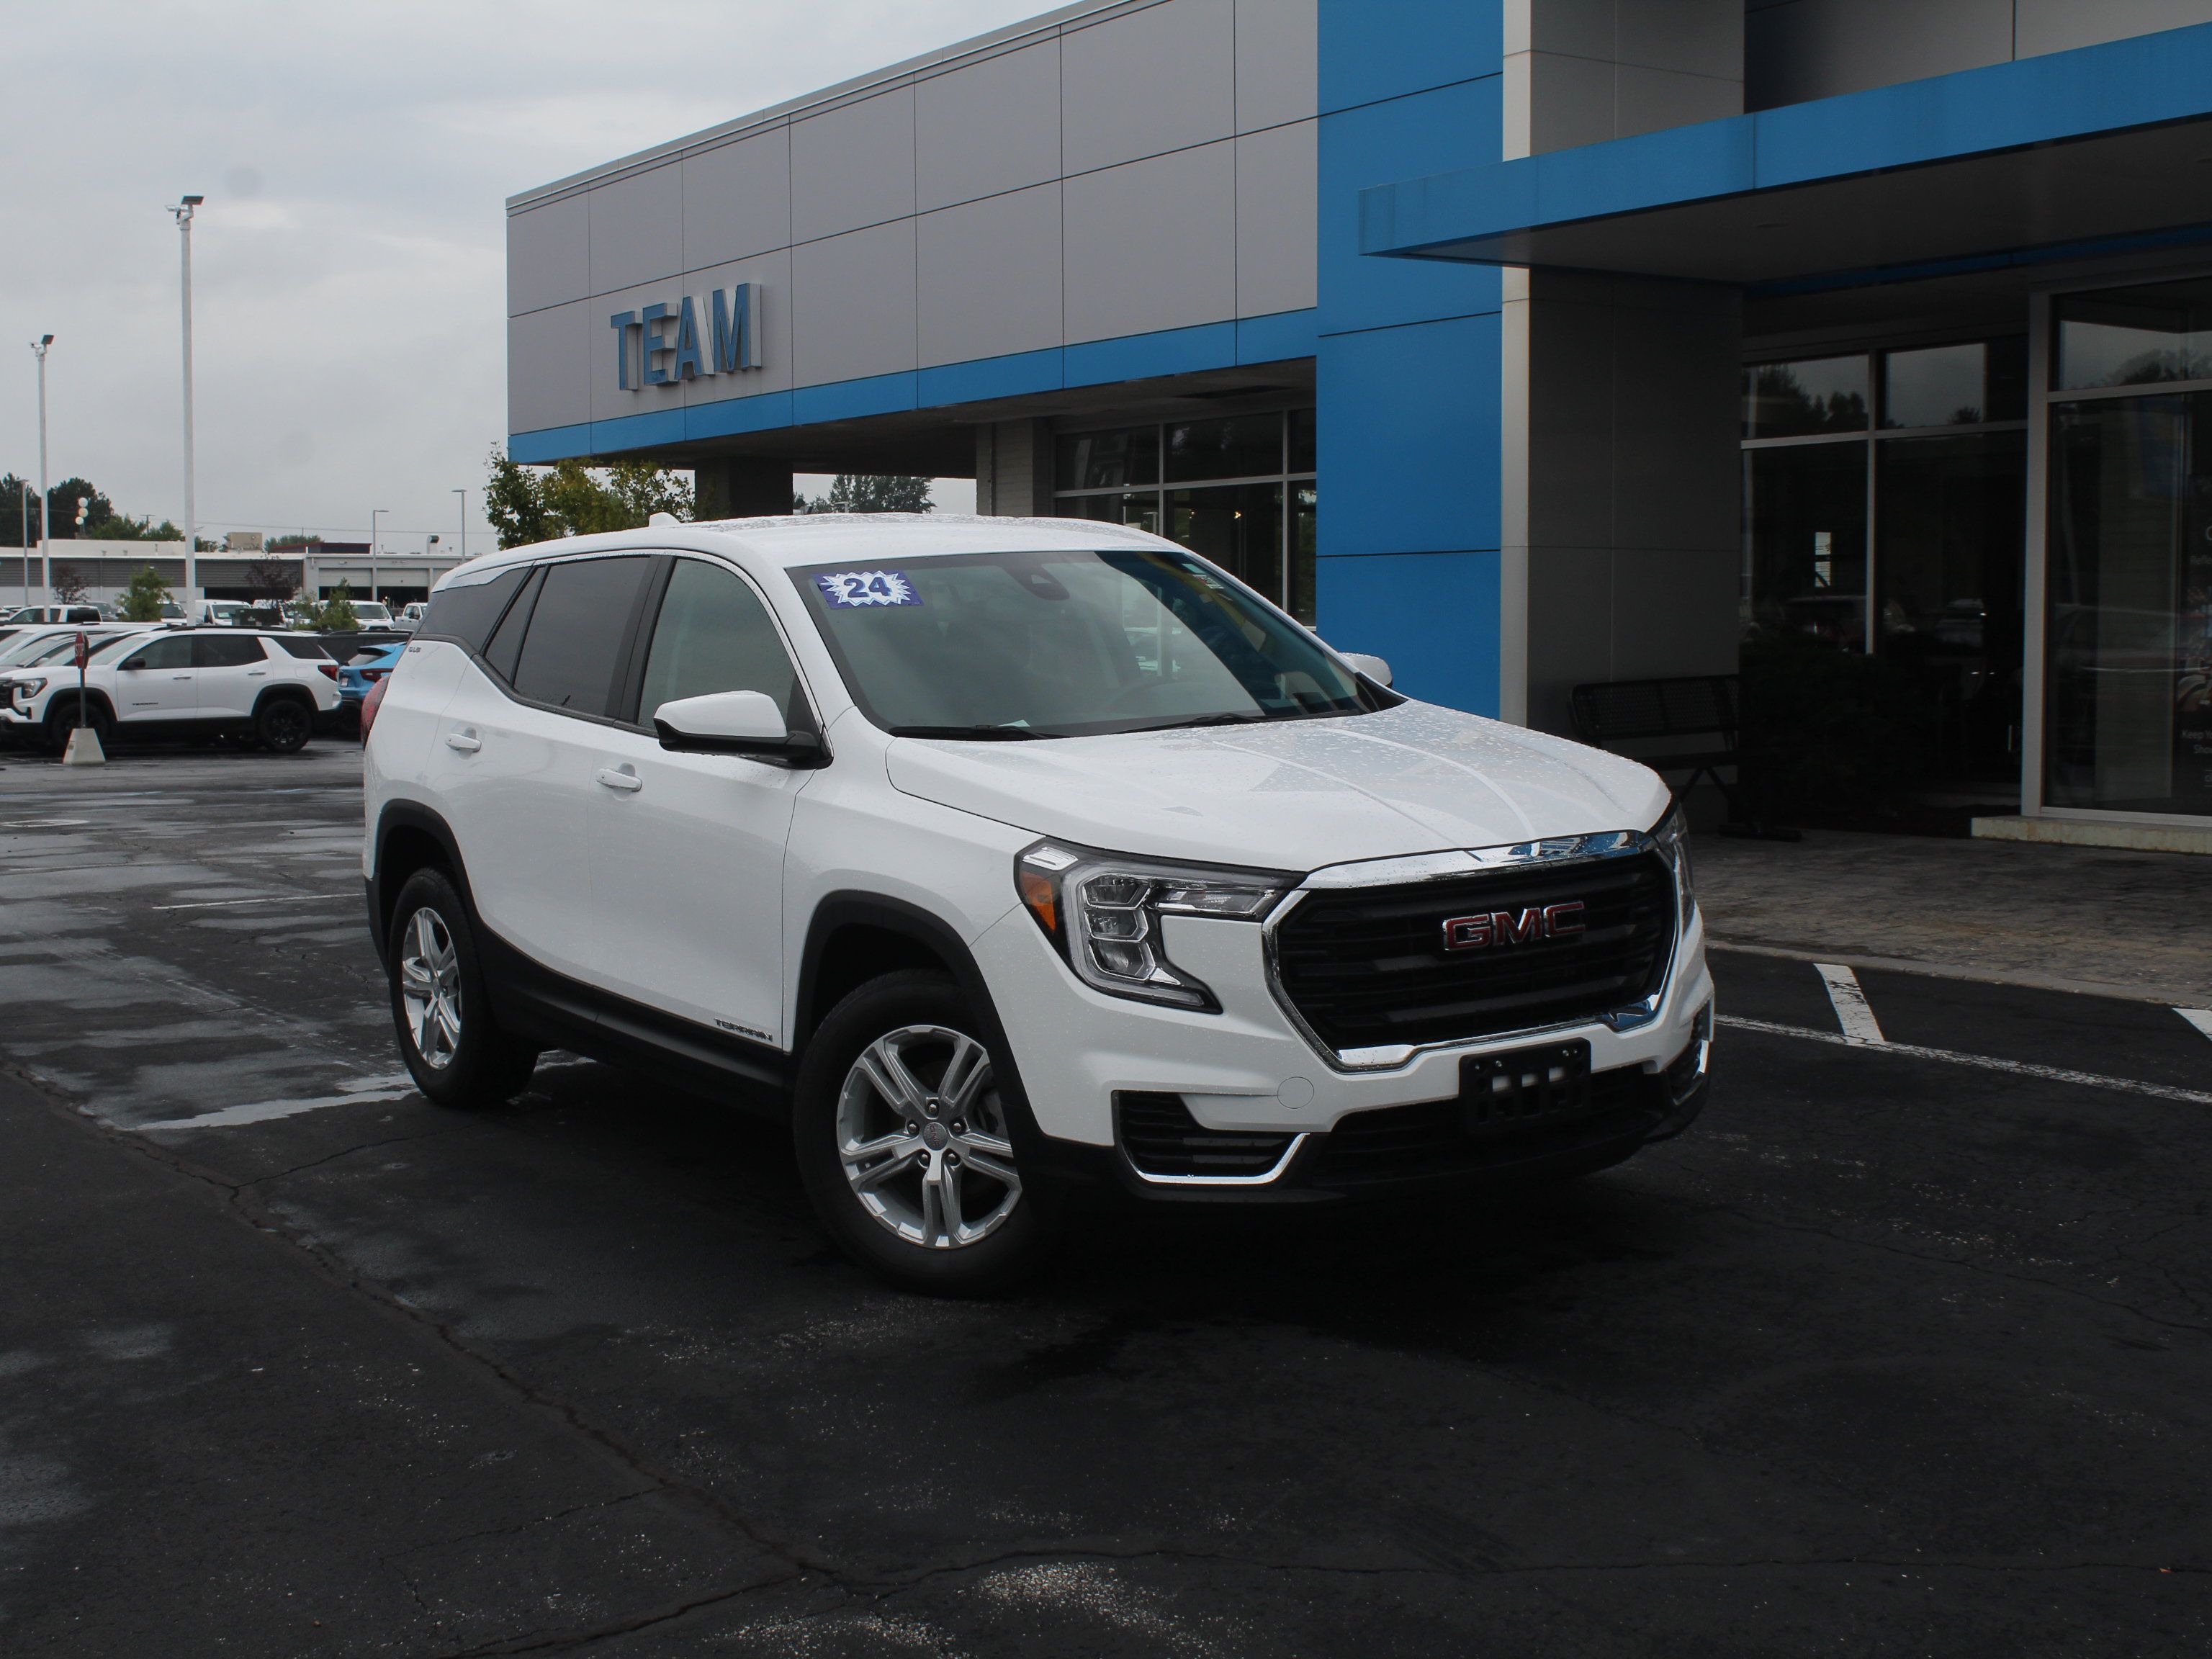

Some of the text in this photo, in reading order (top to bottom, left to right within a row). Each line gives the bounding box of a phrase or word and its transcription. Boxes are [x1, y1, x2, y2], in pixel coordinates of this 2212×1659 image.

[611, 283, 762, 390] TEAM
[843, 577, 892, 598] 24
[1442, 901, 1586, 950] GMC
